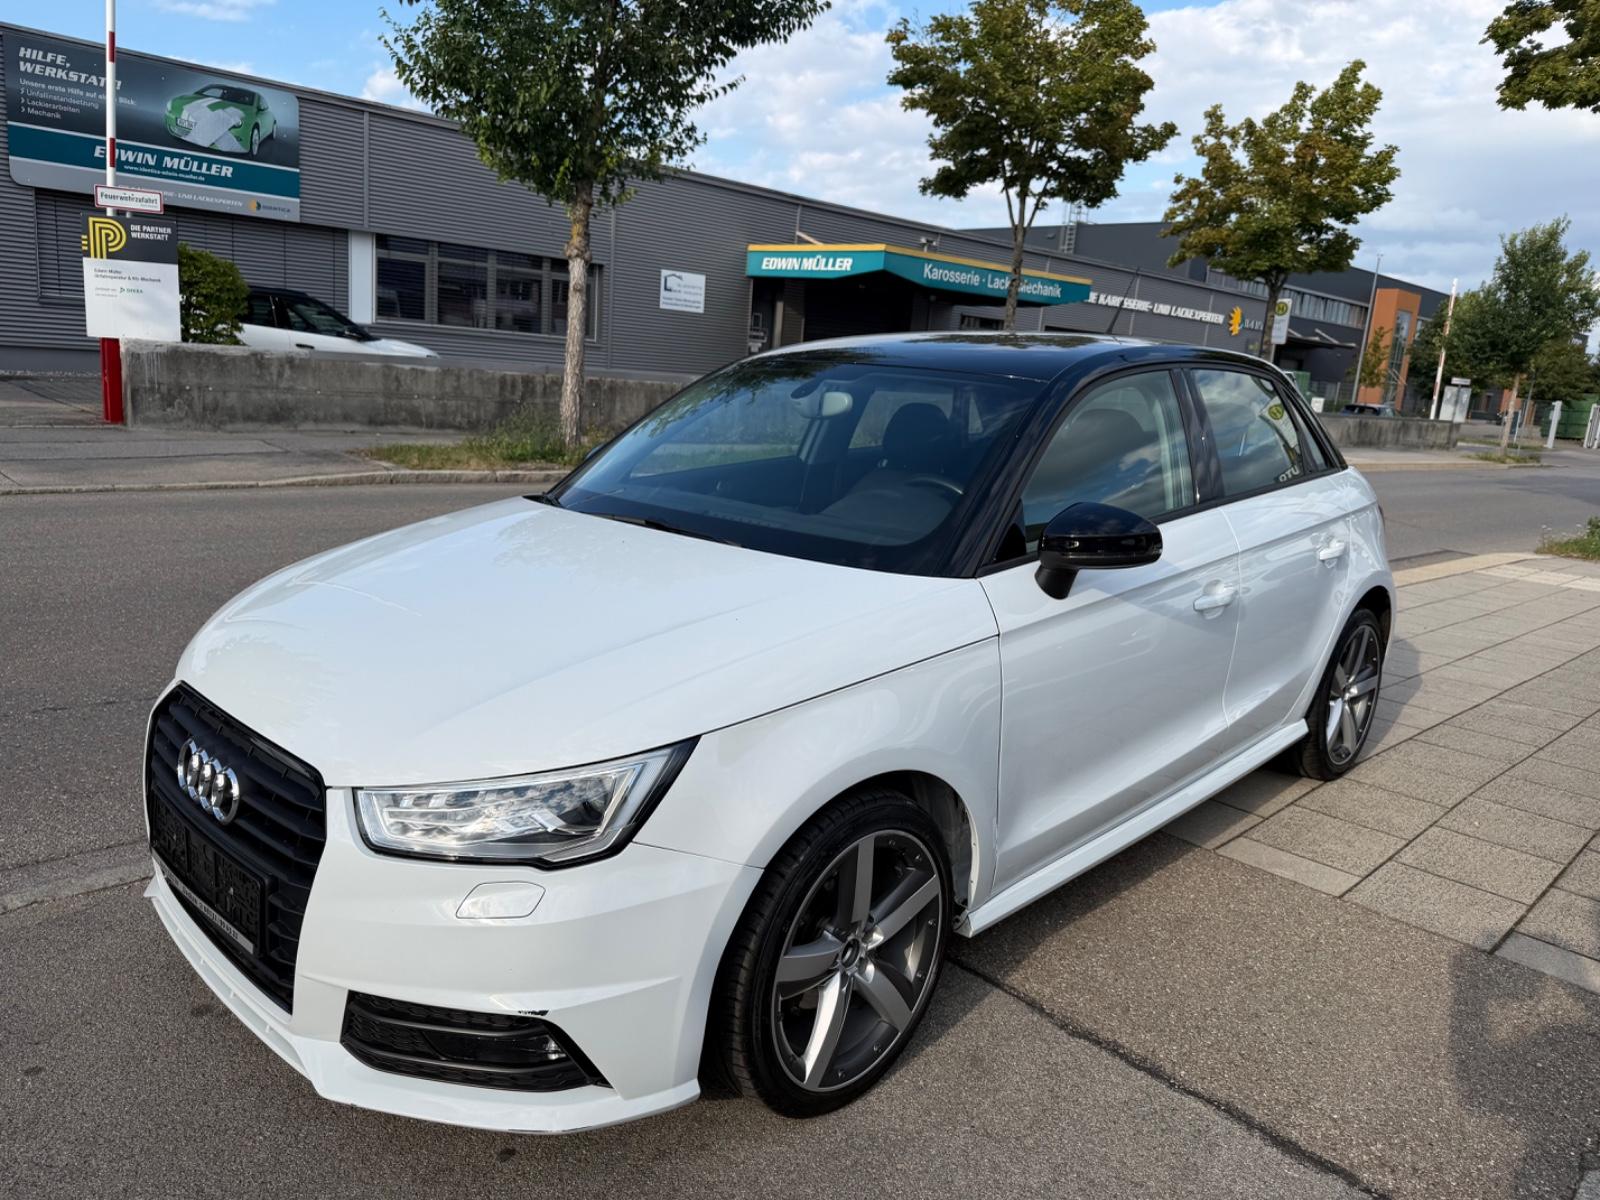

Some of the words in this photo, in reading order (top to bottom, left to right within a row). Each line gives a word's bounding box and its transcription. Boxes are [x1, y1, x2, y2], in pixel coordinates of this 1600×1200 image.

[19, 47, 70, 68] HILFE,
[19, 61, 122, 90] WERKSTAT!
[20, 78, 46, 89] Unsere
[47, 83, 66, 92] erste
[67, 85, 83, 96] Hilfe
[85, 91, 97, 99] auf
[26, 88, 99, 110] Unfallinstandsetzung
[27, 98, 80, 113] Lackierarbeiten
[27, 107, 61, 119] Mechanik
[94, 145, 157, 166] EWIN
[162, 156, 233, 177] MÜLLER
[100, 191, 158, 205] Feuerwehrzufahrt
[130, 224, 141, 232] DIE
[142, 225, 172, 234] PARTNER
[130, 231, 169, 241] WERKSTATT
[761, 256, 801, 270] EDWIN
[801, 254, 853, 271] MÜLLER
[923, 262, 980, 286] Karosserie
[1153, 302, 1171, 315] UND
[1171, 305, 1225, 324] LACKEXPERTEN
